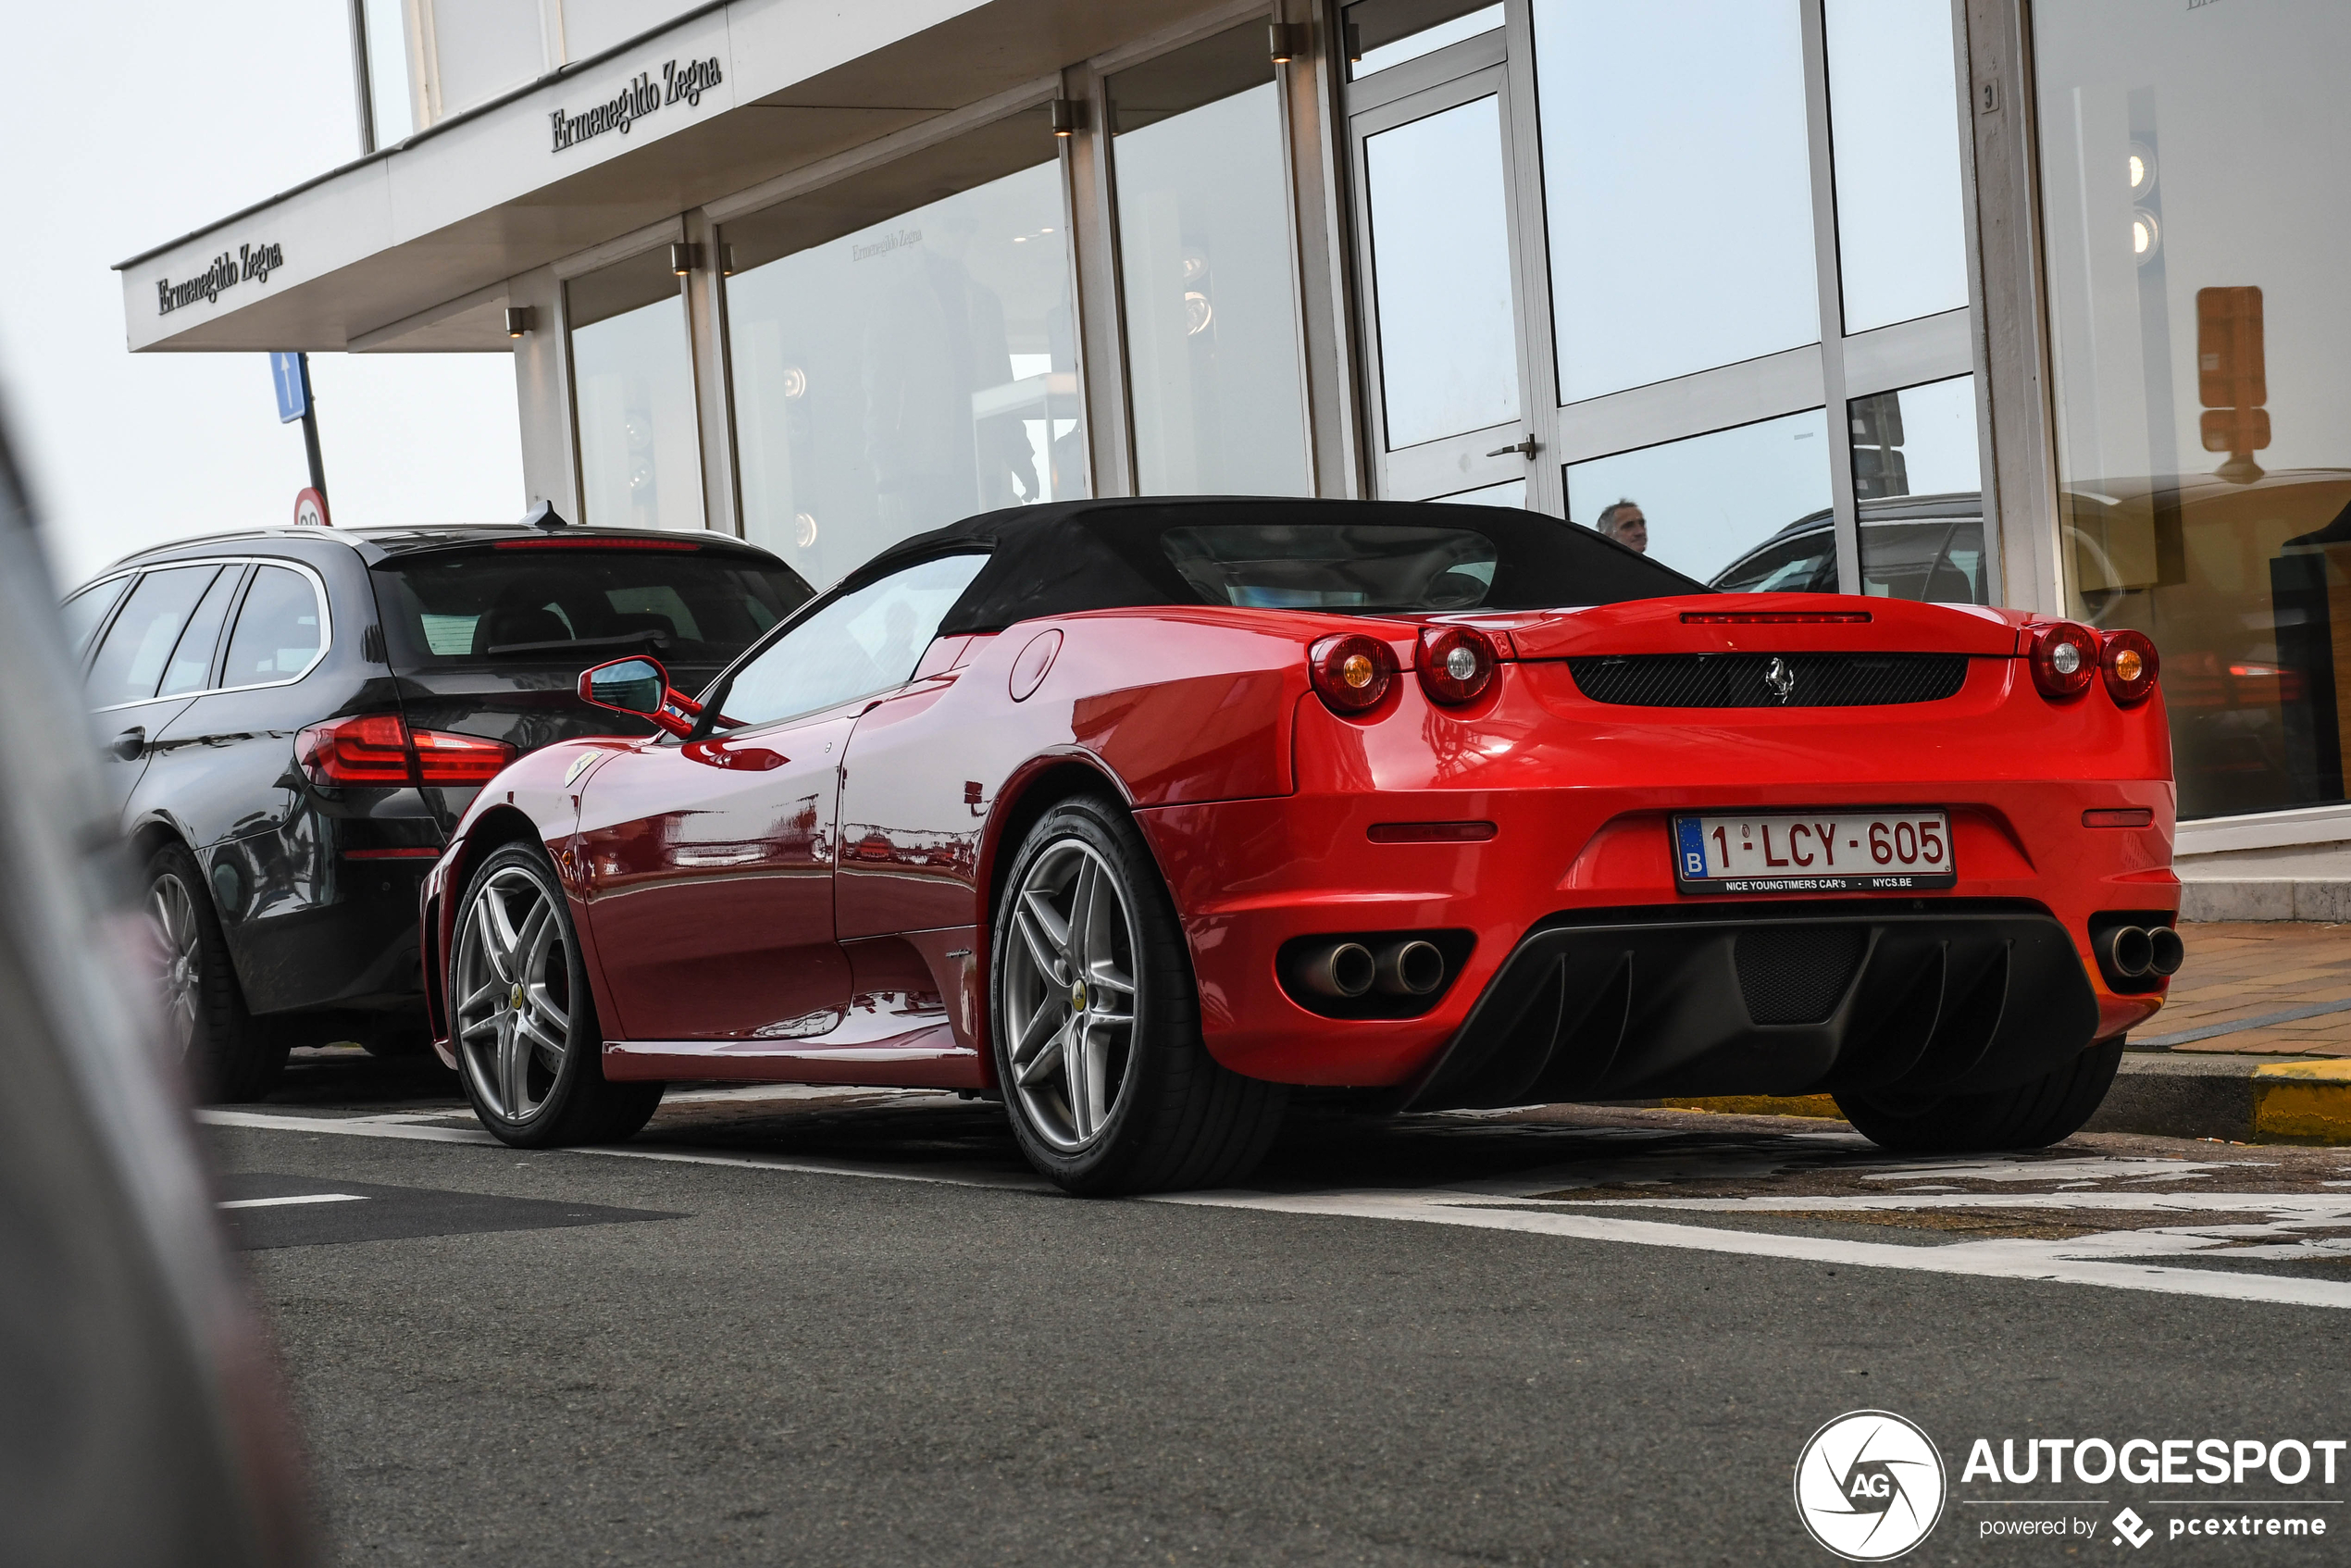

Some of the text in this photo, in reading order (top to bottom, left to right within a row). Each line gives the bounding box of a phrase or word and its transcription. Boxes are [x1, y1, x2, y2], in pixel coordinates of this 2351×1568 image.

[549, 56, 722, 153] Ermenegildo Zegna
[852, 229, 923, 262] Ermenegildo Zegna
[155, 243, 283, 316] Ermenegildo Zegna
[1686, 852, 1703, 873] B
[1710, 821, 1945, 868] 1-LCY-605
[1726, 881, 1748, 890] NICE
[1749, 880, 1817, 890] YOUNGTIMERS
[1819, 879, 1847, 889] CAR's
[1872, 877, 1912, 888] NYCS.BE
